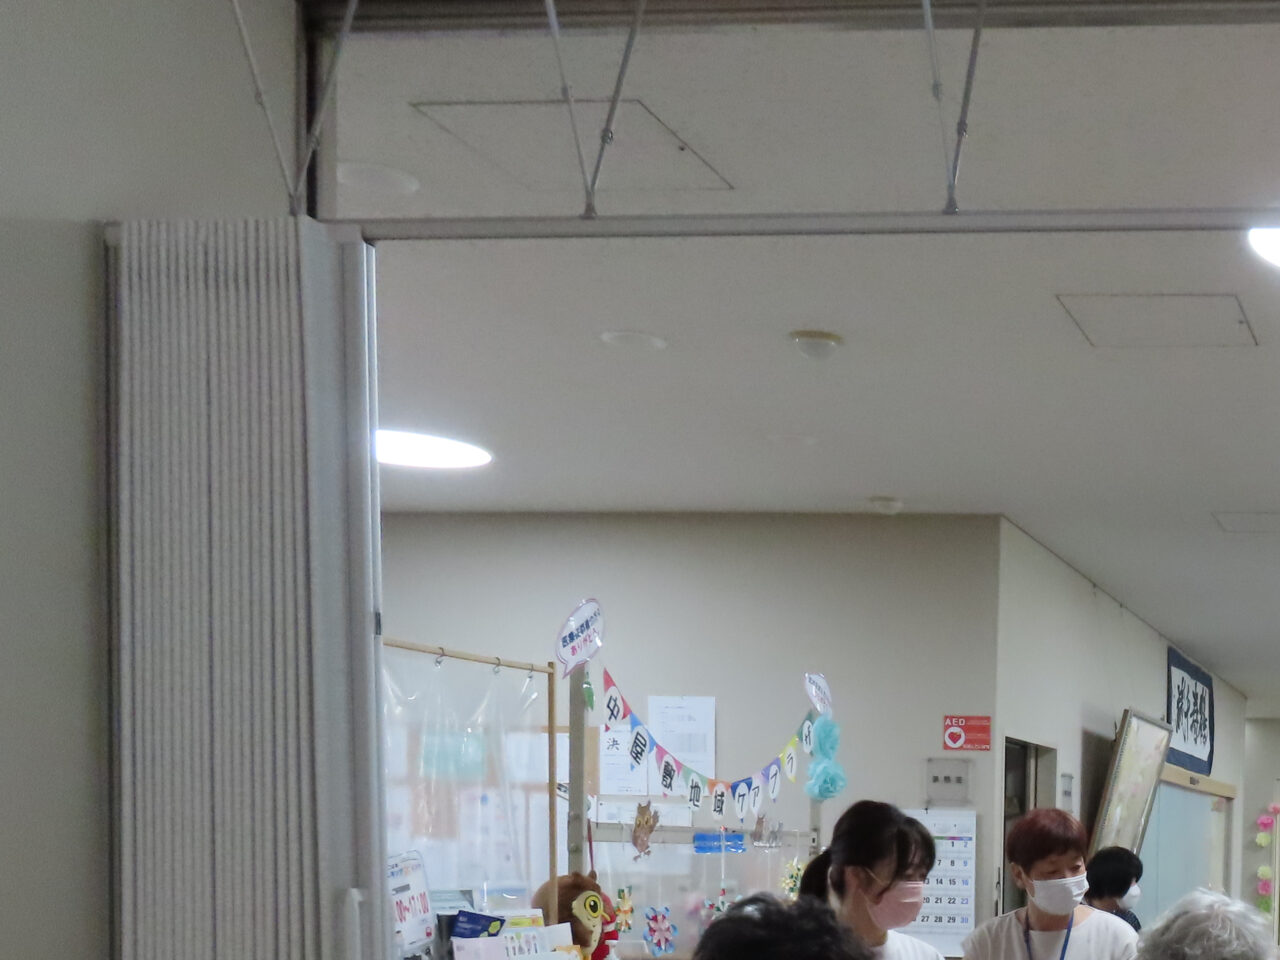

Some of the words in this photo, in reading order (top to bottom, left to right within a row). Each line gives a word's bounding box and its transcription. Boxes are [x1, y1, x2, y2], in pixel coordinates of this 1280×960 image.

[945, 718, 965, 726] AED
[949, 878, 956, 886] 15
[947, 897, 956, 905] 22
[920, 915, 930, 923] 27
[947, 916, 956, 924] 29
